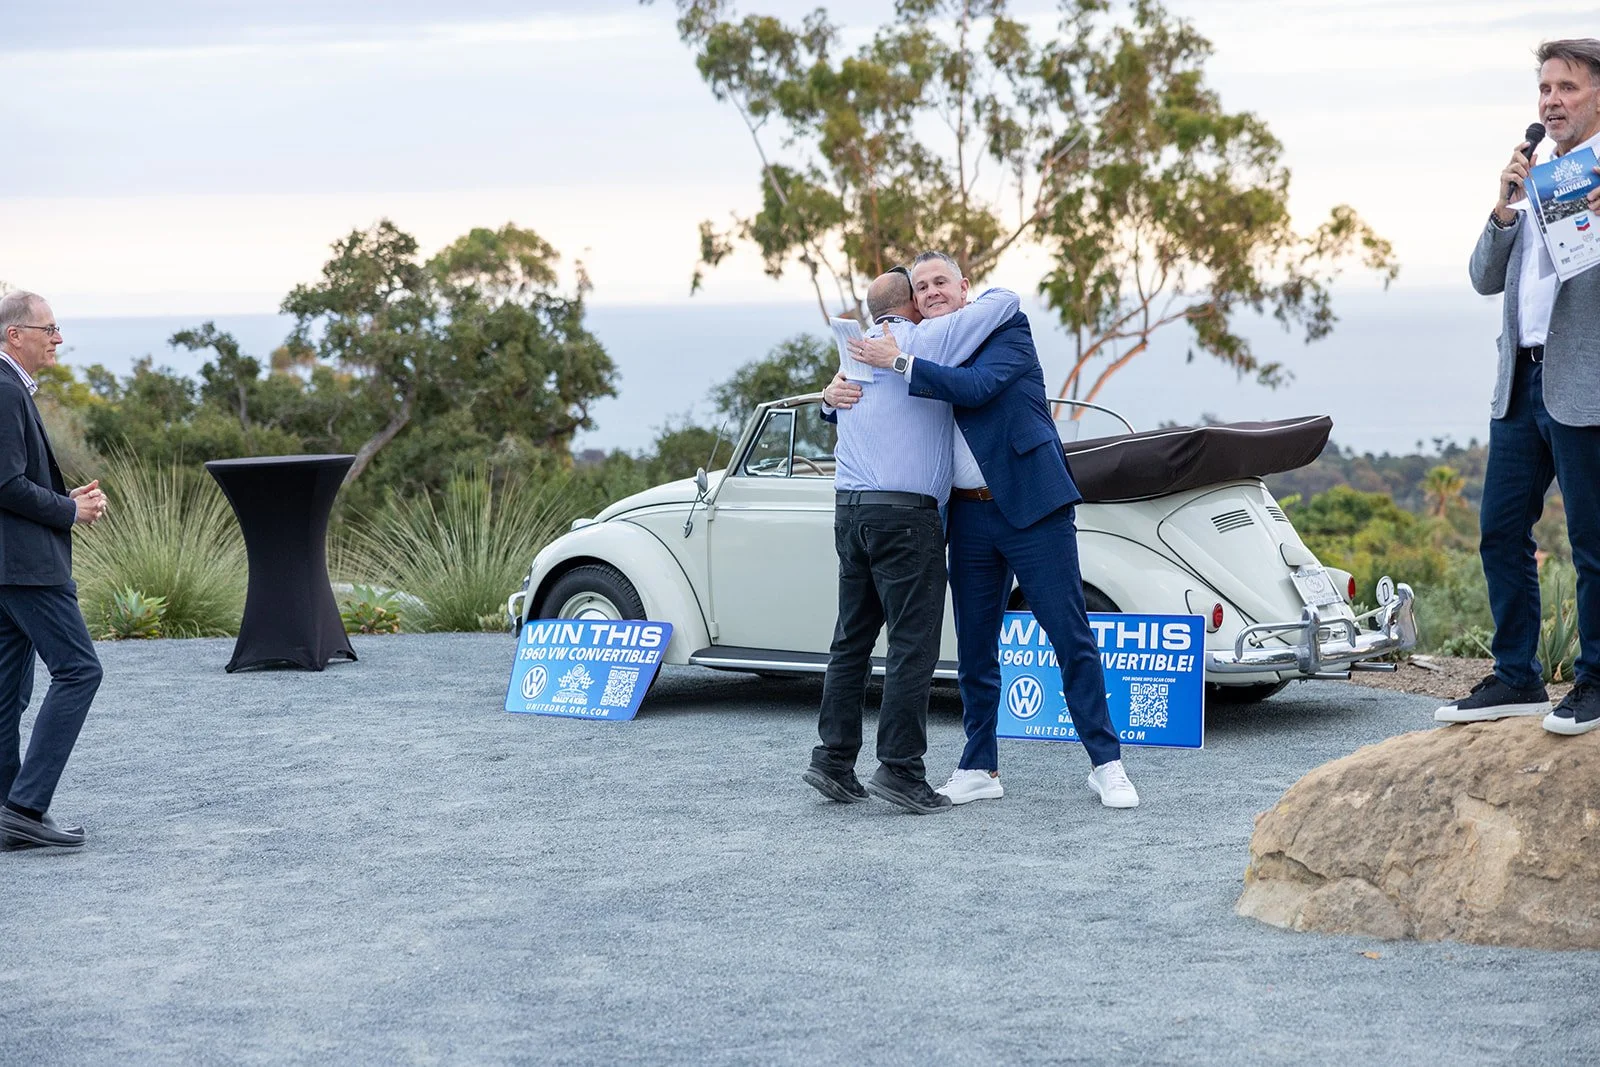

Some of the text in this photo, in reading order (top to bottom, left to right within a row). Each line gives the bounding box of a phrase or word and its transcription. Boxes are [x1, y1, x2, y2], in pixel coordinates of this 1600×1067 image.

[527, 623, 663, 648] WIN THIS
[1000, 619, 1191, 650] WI THIS
[519, 647, 660, 665] 1960 VW CONVERTIBLE!
[525, 703, 610, 716] UNITEDBG.ORG.COM
